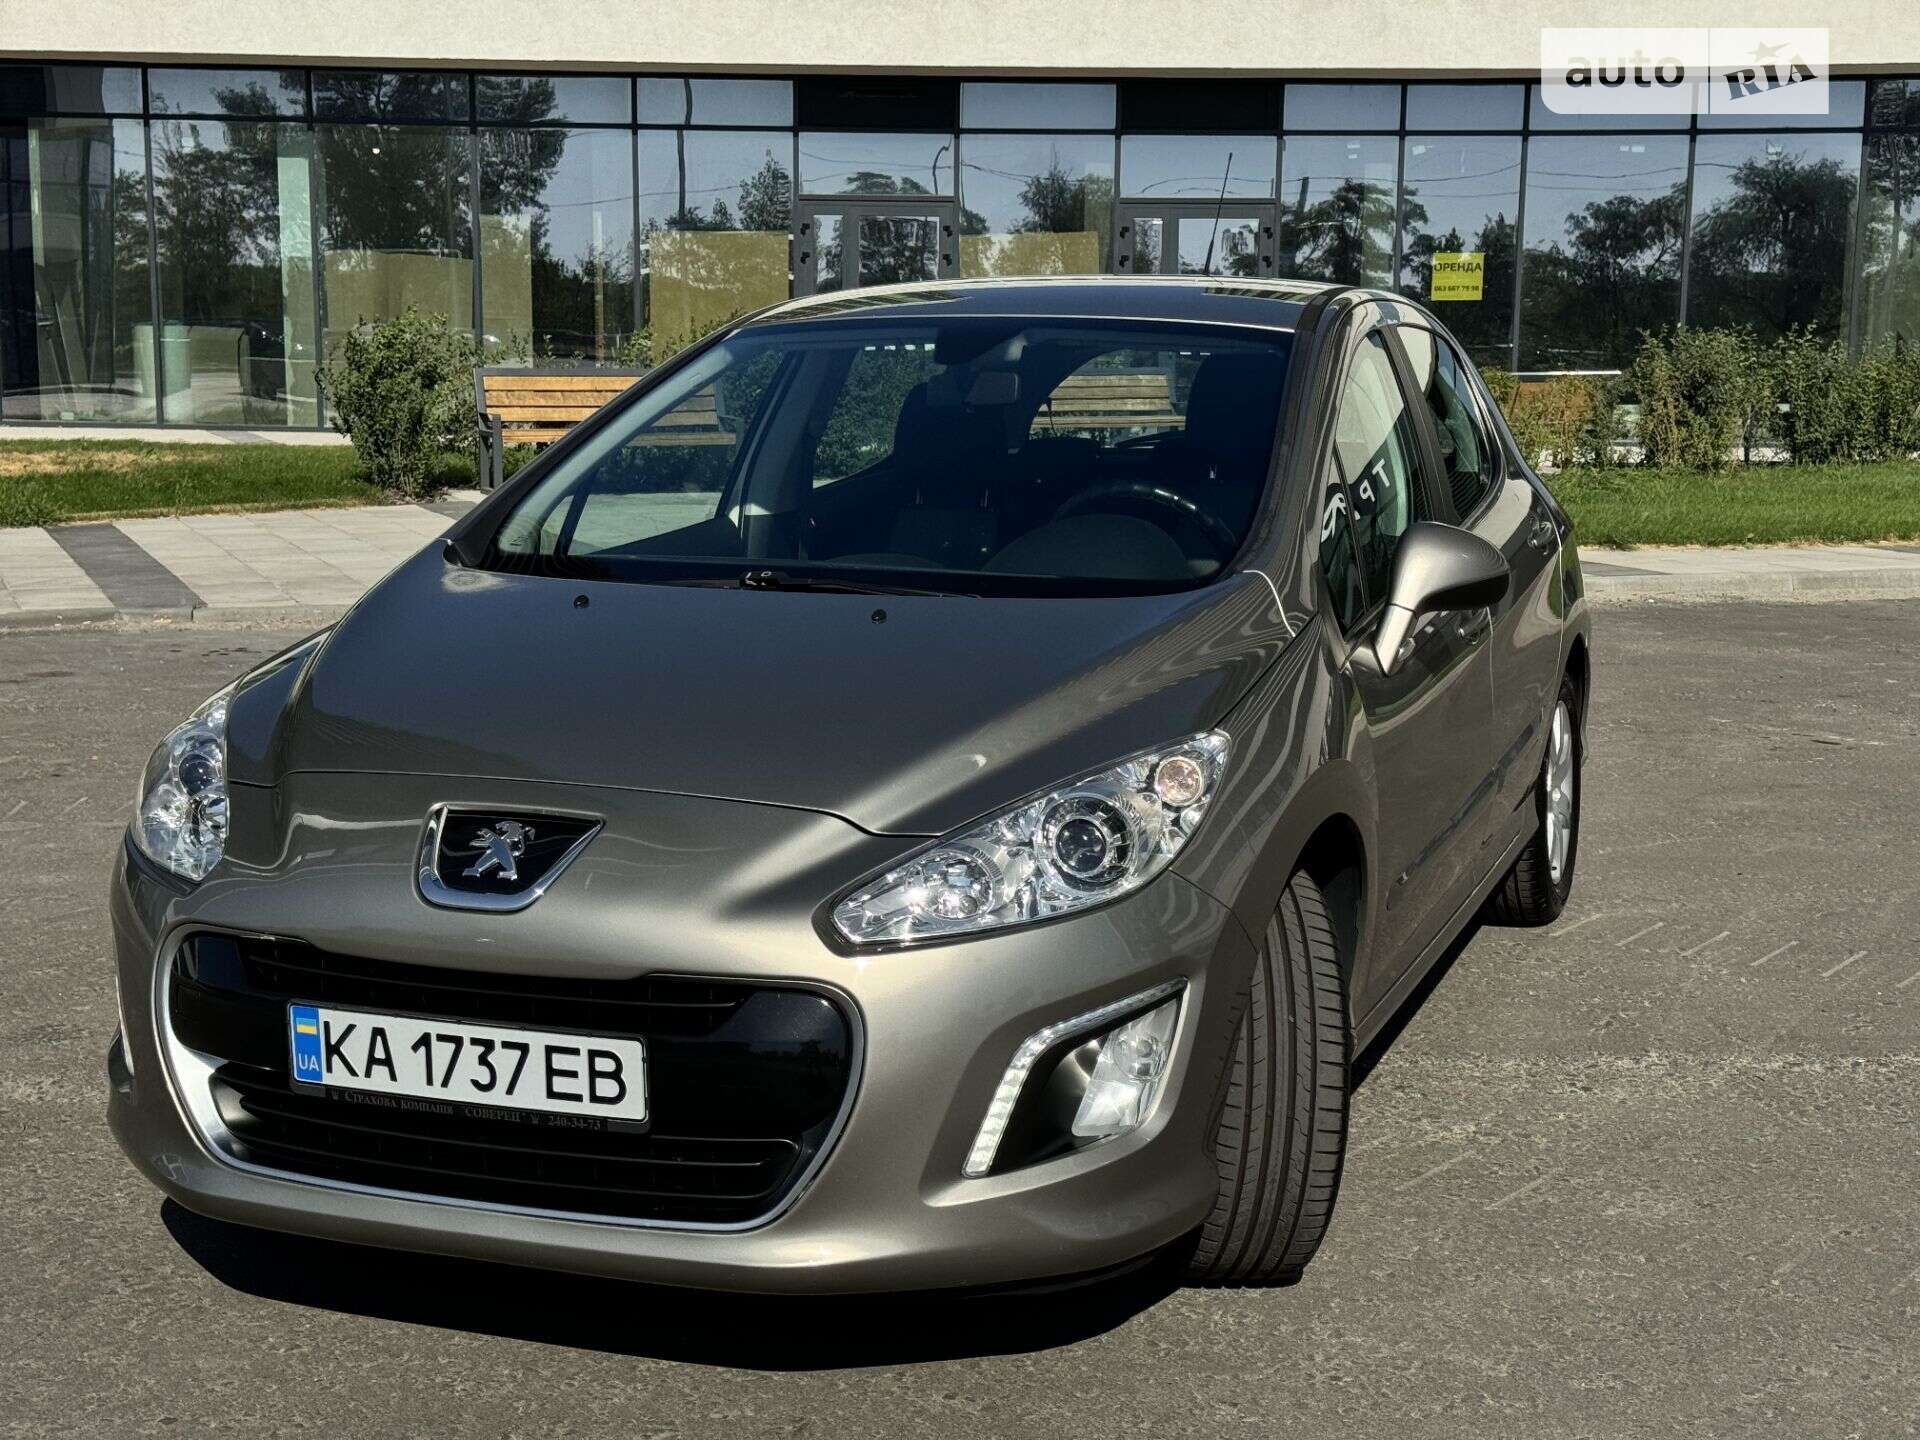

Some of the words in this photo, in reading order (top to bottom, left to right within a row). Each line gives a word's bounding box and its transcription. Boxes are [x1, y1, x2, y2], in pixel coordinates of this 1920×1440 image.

[1433, 262, 1482, 273] ОРЕНДА
[298, 1053, 320, 1072] UA
[323, 1020, 398, 1083] KA
[410, 1031, 531, 1096] 1737
[544, 1044, 628, 1106] EB
